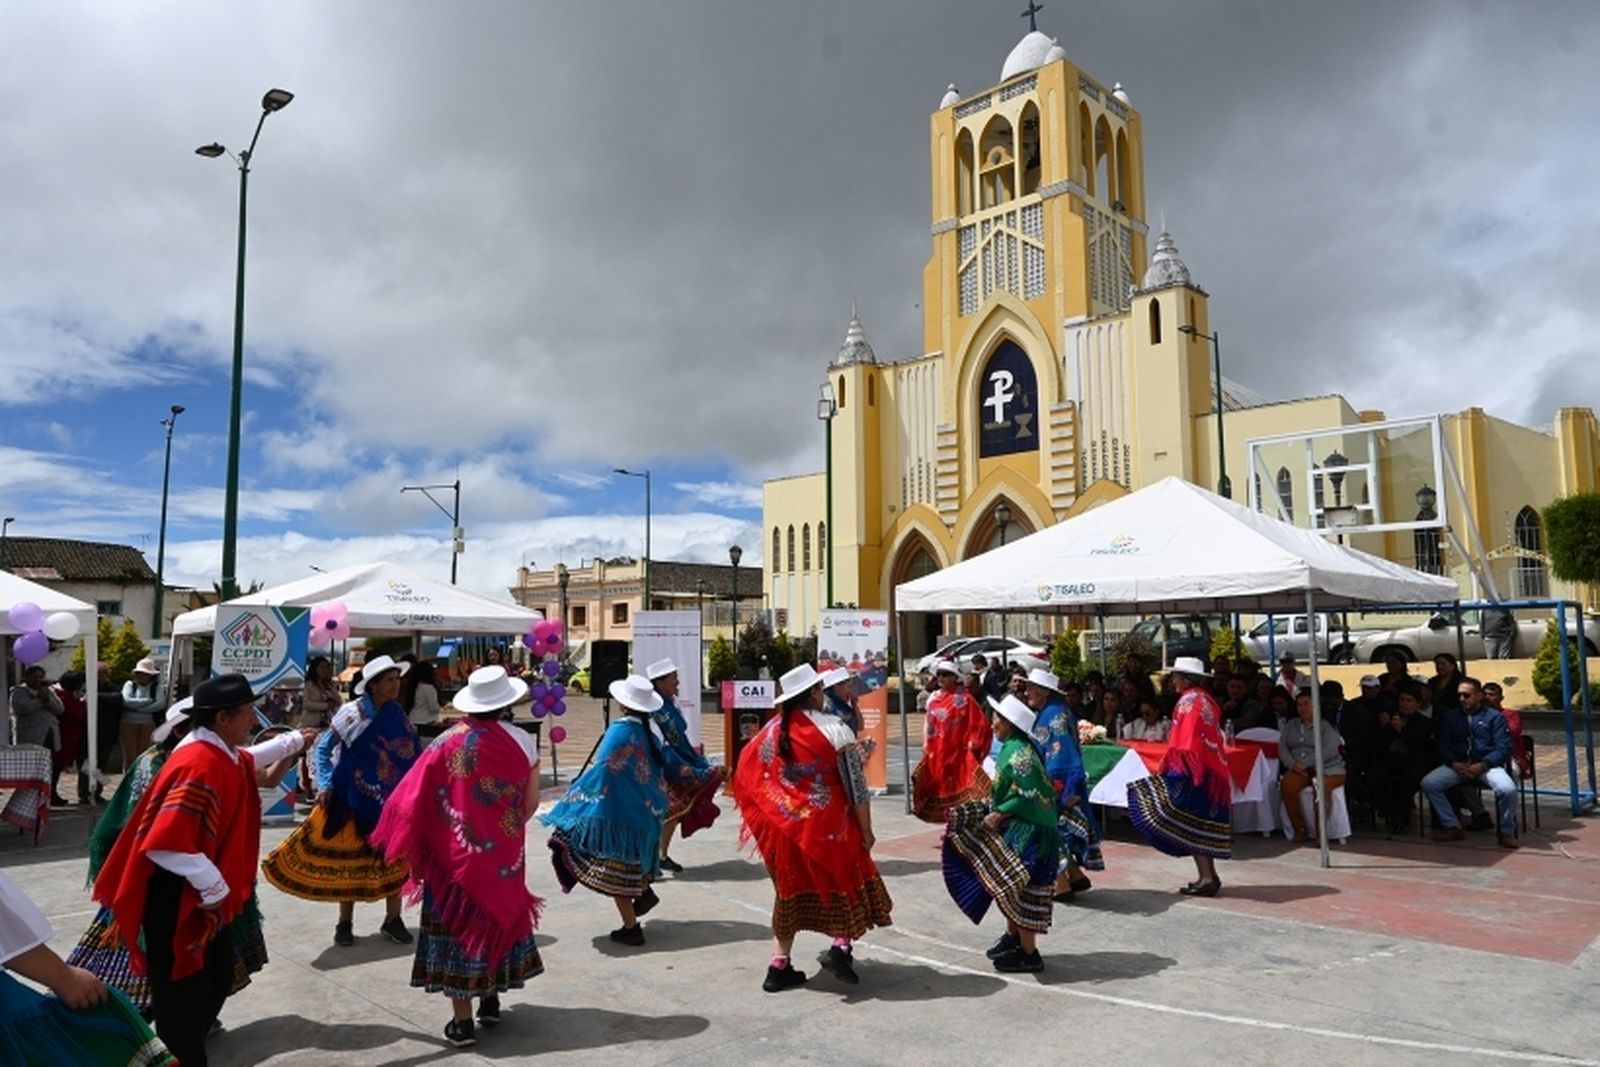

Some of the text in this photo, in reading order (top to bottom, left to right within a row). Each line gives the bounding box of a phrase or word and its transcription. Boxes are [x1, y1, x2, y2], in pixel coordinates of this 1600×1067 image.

[1055, 582, 1096, 594] TISALEO
[222, 648, 273, 658] CCPDT
[741, 686, 764, 696] CAI
